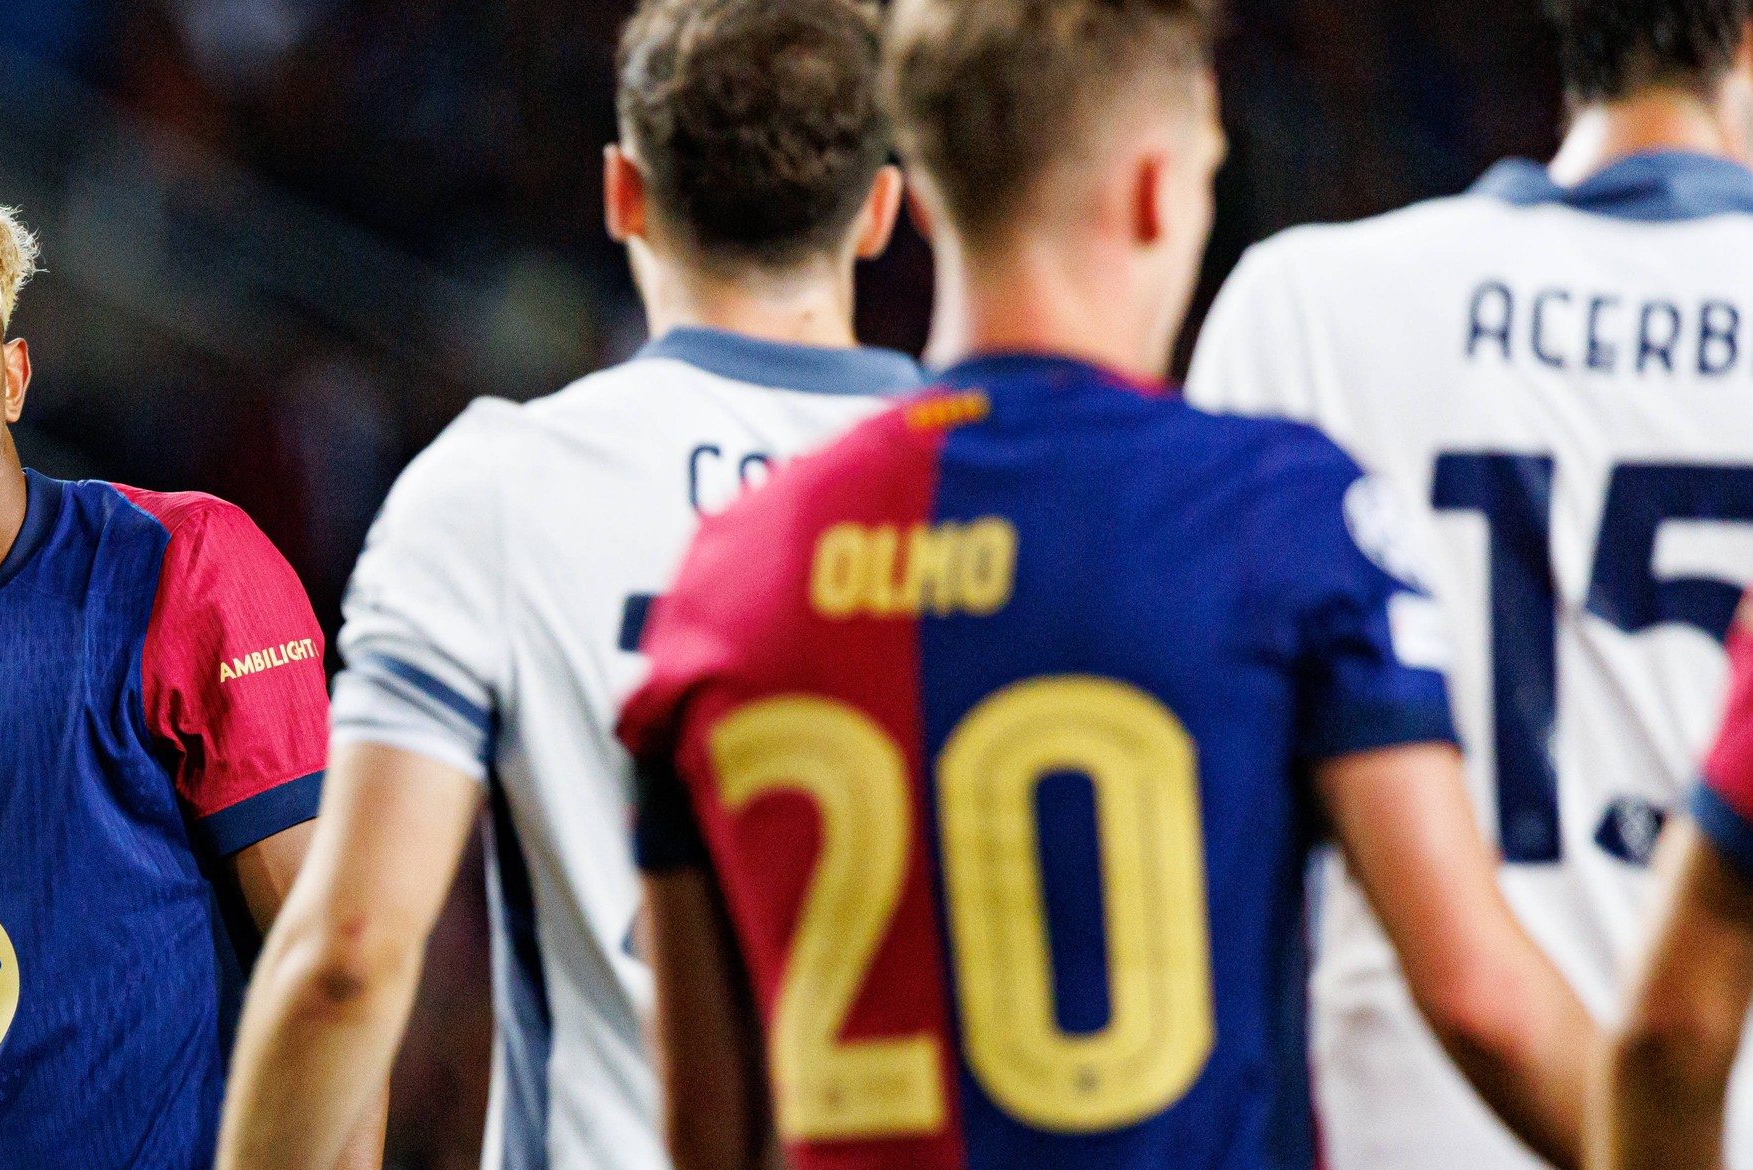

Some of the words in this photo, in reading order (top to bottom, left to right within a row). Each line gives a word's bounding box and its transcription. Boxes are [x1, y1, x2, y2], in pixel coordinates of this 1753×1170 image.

[1464, 281, 1753, 376] ACERB
[812, 518, 1018, 617] OLMO
[220, 638, 314, 683] AMBILIGHT
[710, 674, 1216, 1145] 20
